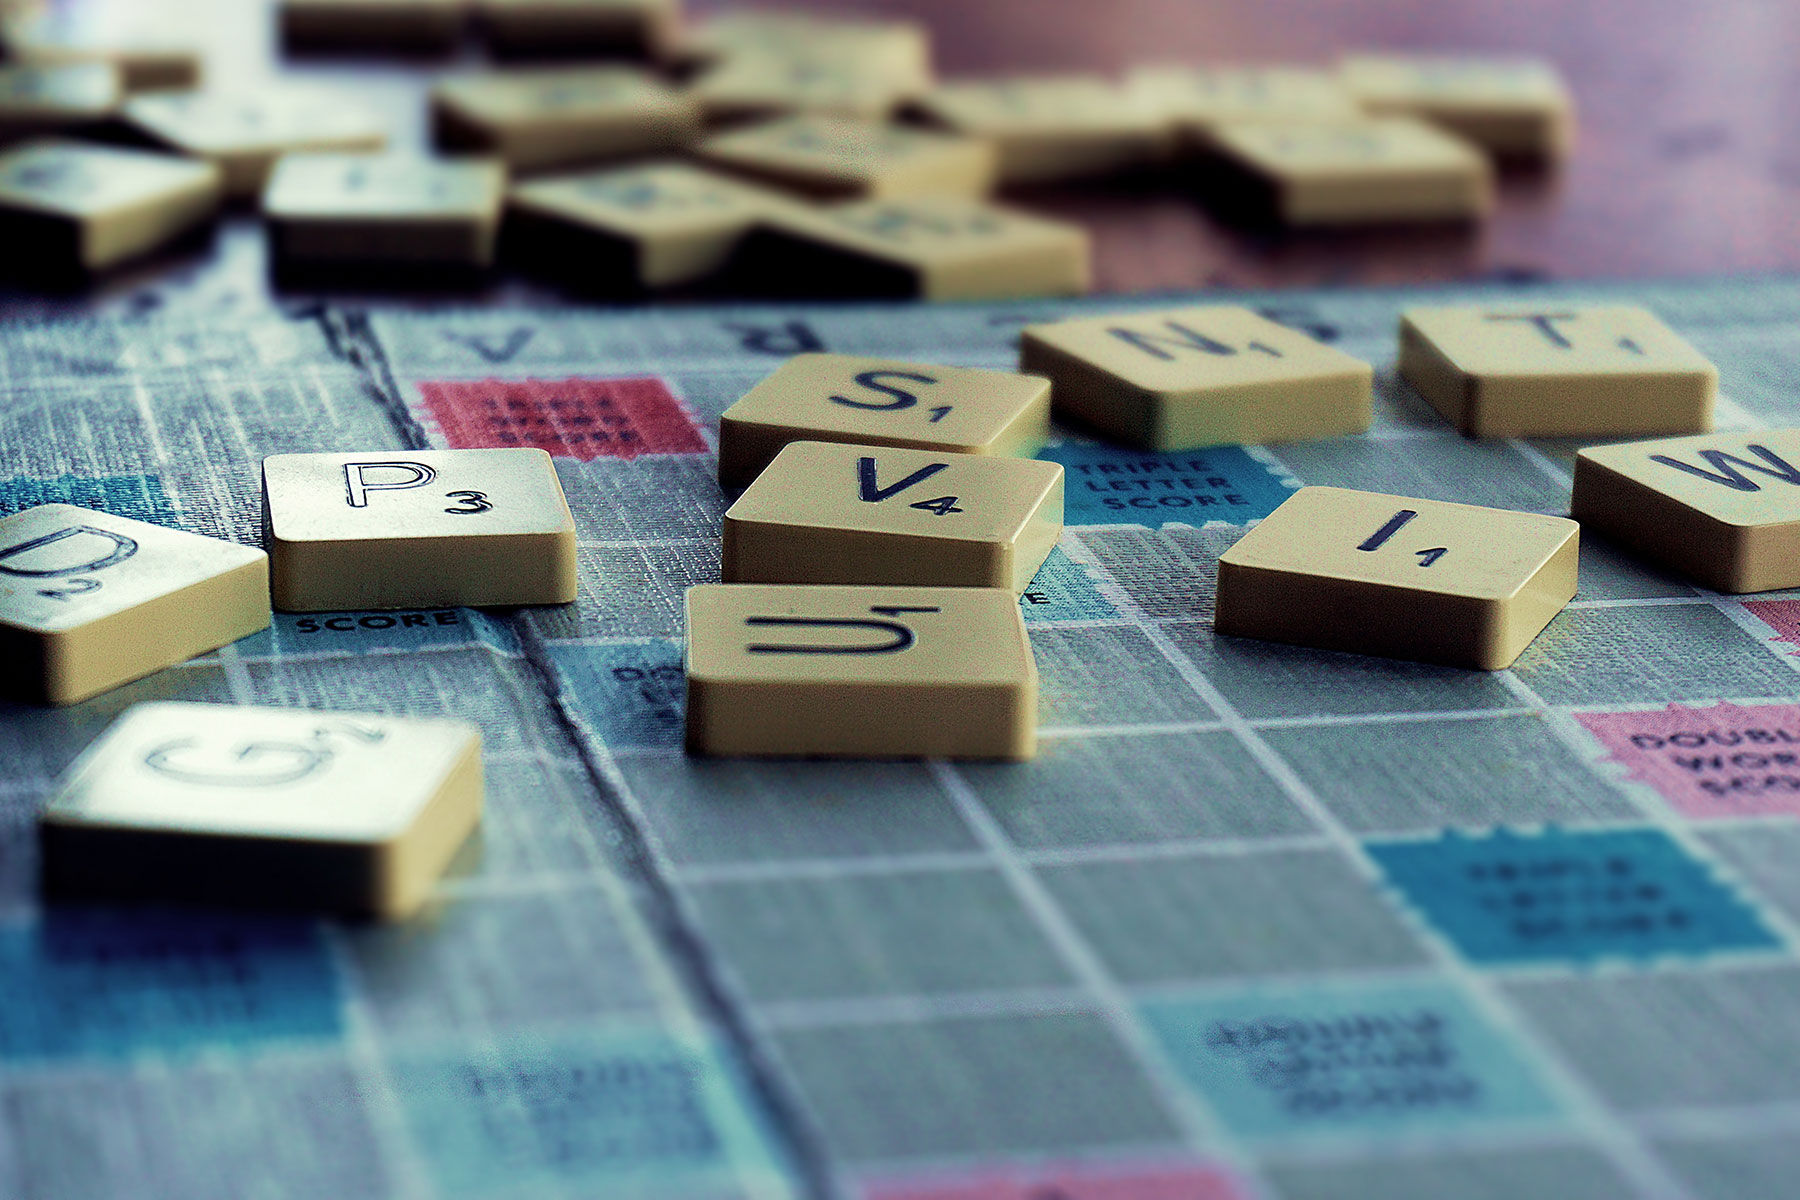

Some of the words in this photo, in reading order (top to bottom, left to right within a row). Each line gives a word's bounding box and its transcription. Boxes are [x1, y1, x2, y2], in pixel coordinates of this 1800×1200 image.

[1104, 320, 1239, 361] N
[1484, 313, 1576, 350] T
[829, 371, 939, 411] S
[857, 456, 950, 504] V
[908, 496, 964, 516] 4
[1072, 461, 1212, 475] TRIPLE
[1085, 477, 1232, 492] LETTER
[1649, 444, 1800, 492] W
[341, 461, 438, 508] P
[444, 490, 494, 514] 3
[1102, 494, 1251, 510] SCORE
[296, 611, 459, 633] SCORE
[746, 616, 916, 654] U
